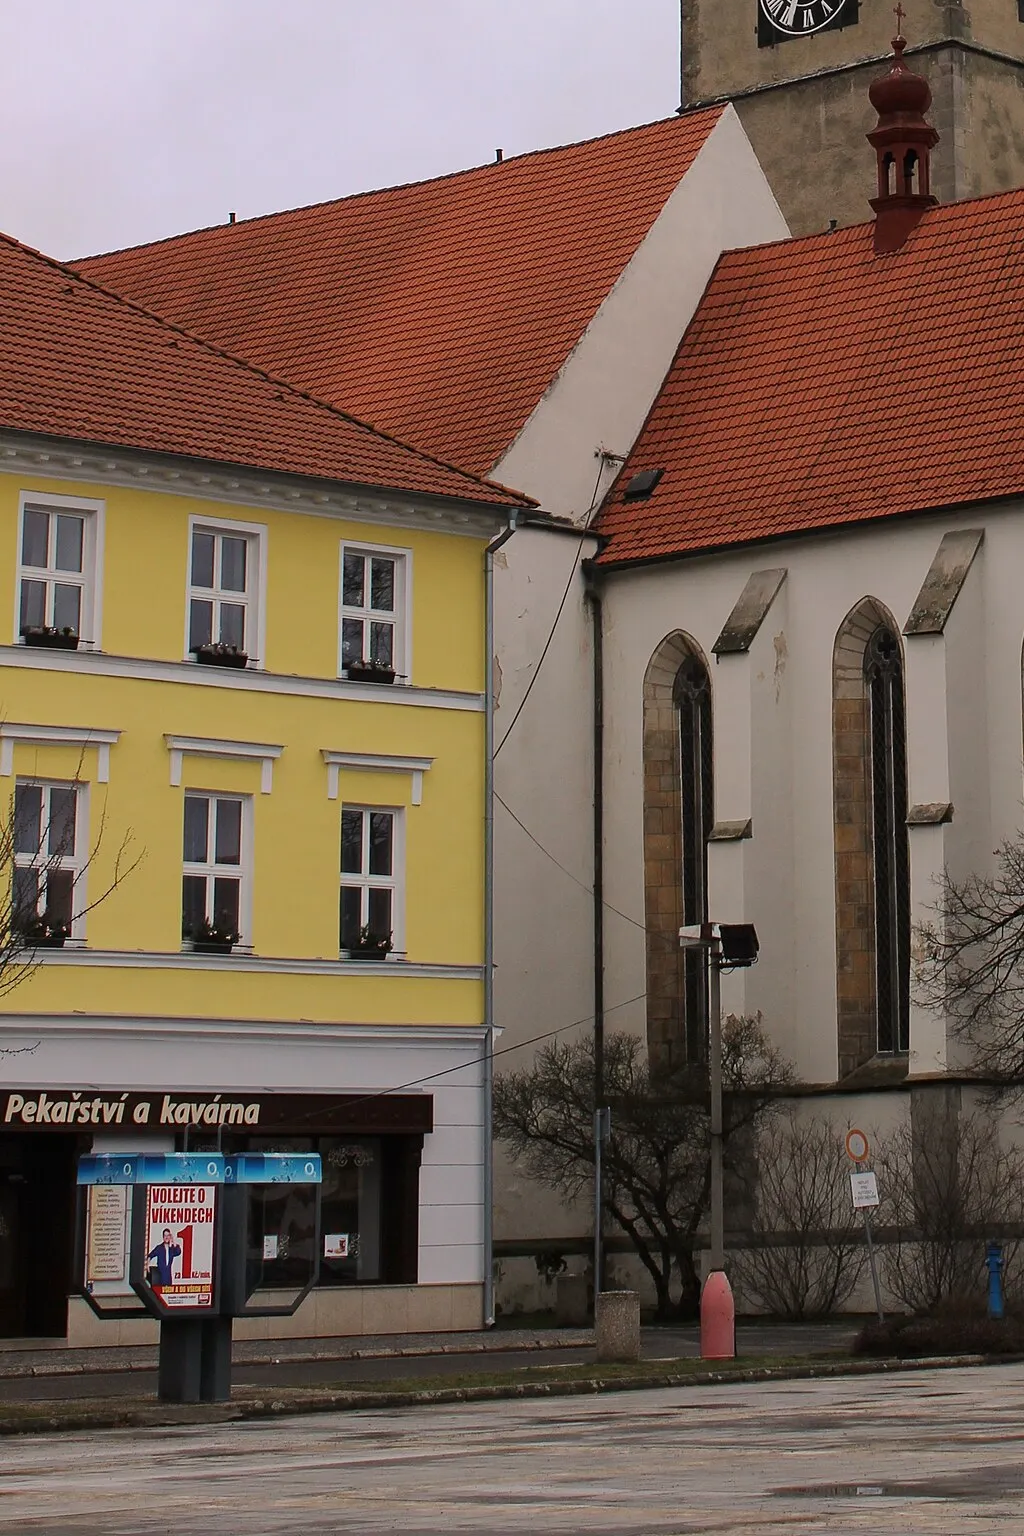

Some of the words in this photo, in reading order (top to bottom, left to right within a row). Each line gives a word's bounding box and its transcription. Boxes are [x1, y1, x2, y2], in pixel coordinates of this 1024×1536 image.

[821, 0, 833, 17] V
[803, 9, 815, 28] VI
[4, 1092, 129, 1124] Pekařství
[133, 1101, 151, 1124] a
[159, 1094, 260, 1124] kavárna
[152, 1188, 196, 1204] VOLEJTE
[198, 1188, 206, 1204] O
[152, 1205, 213, 1224] VÍKENDECH
[177, 1225, 193, 1279] 1
